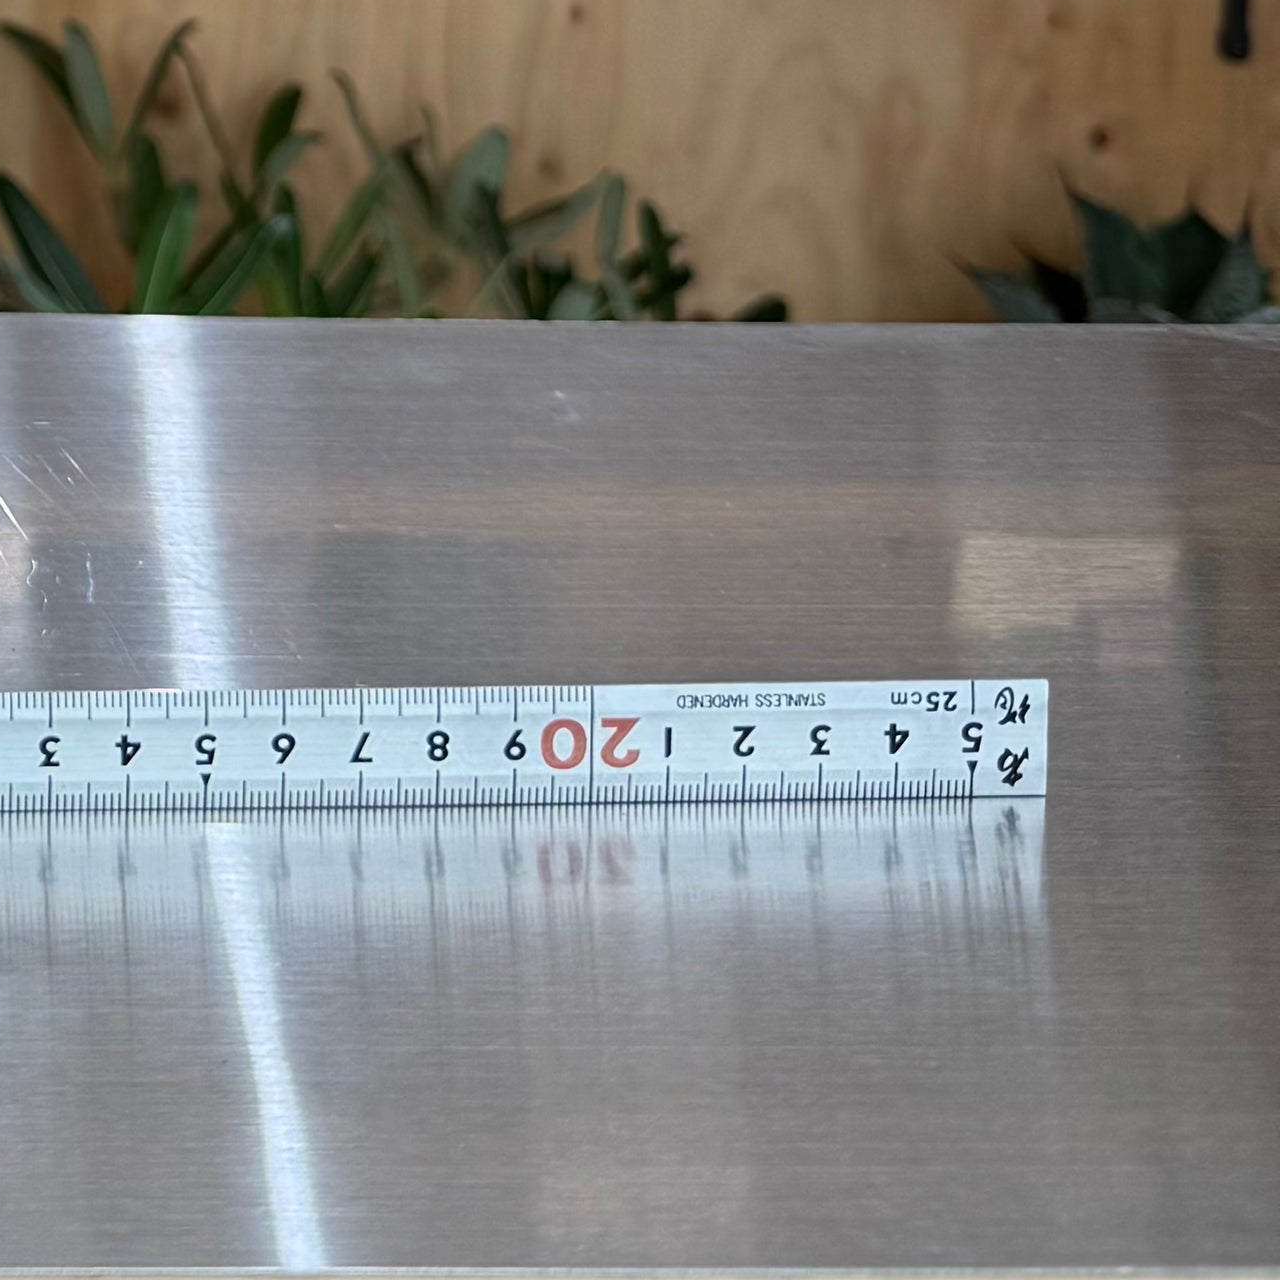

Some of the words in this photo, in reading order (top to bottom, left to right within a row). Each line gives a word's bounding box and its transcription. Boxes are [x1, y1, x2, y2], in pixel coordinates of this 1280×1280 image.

[676, 694, 749, 709] HARDENED
[754, 692, 826, 708] STAINLESS
[39, 736, 61, 767] 3
[115, 734, 142, 767] 4
[195, 734, 217, 766] 5
[271, 733, 297, 765] 6
[350, 732, 374, 763] 7
[426, 730, 450, 762] 8
[504, 729, 527, 761] 9
[540, 717, 641, 771] 20
[665, 727, 673, 758] 1
[732, 725, 757, 757] 2
[810, 724, 832, 756] 3
[884, 723, 911, 755] 4
[960, 721, 984, 754] 5
